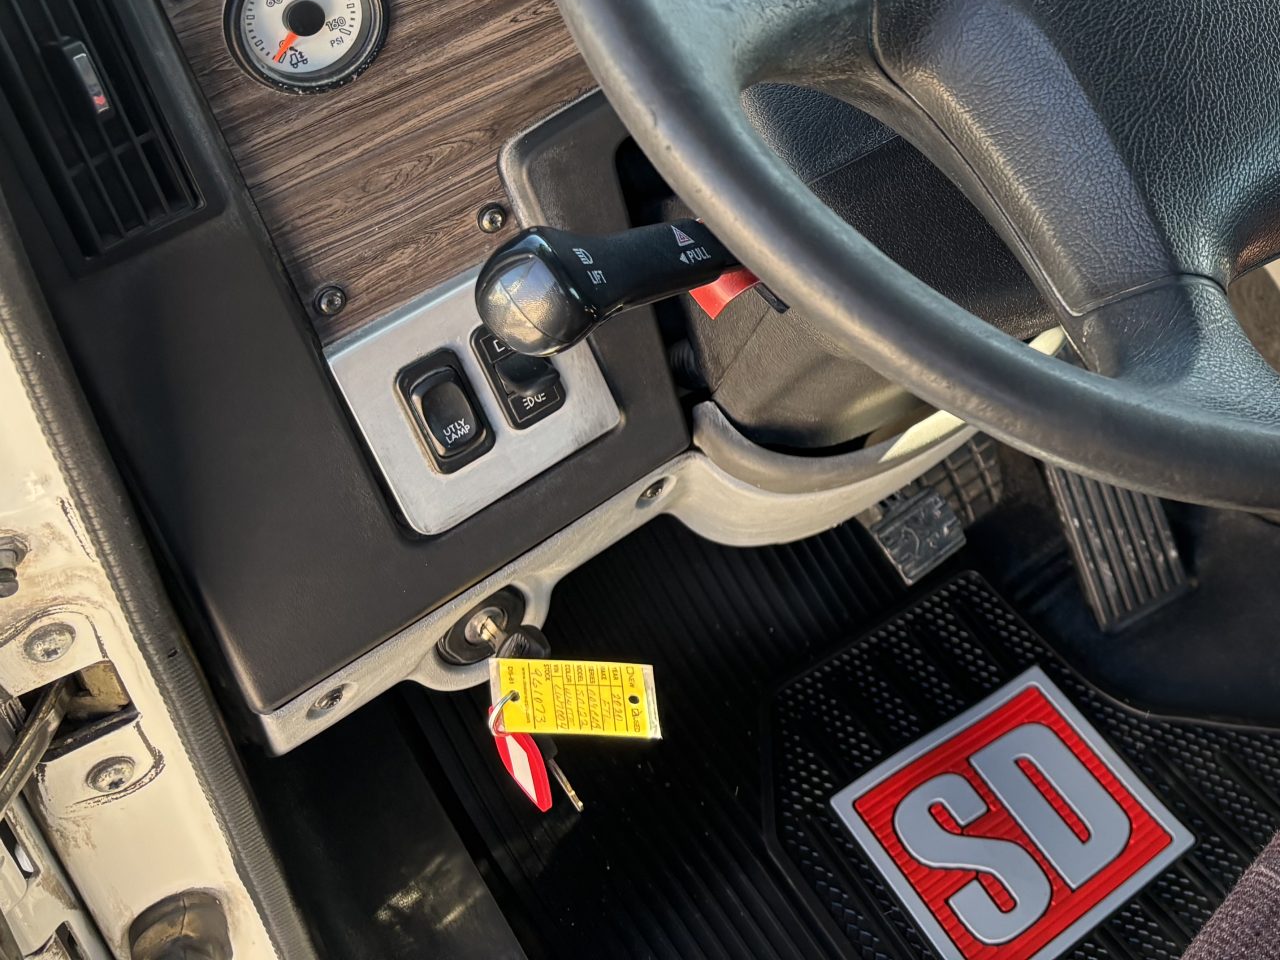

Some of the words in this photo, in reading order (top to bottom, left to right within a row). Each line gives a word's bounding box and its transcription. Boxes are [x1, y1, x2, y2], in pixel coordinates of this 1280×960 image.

[326, 16, 346, 31] 160
[329, 36, 344, 48] PSI
[687, 247, 712, 264] PULL
[587, 269, 607, 284] LIFT
[443, 418, 466, 436] UTLY
[445, 424, 471, 443] LAMP
[543, 664, 551, 681] STOCK
[893, 721, 1132, 946] SD
